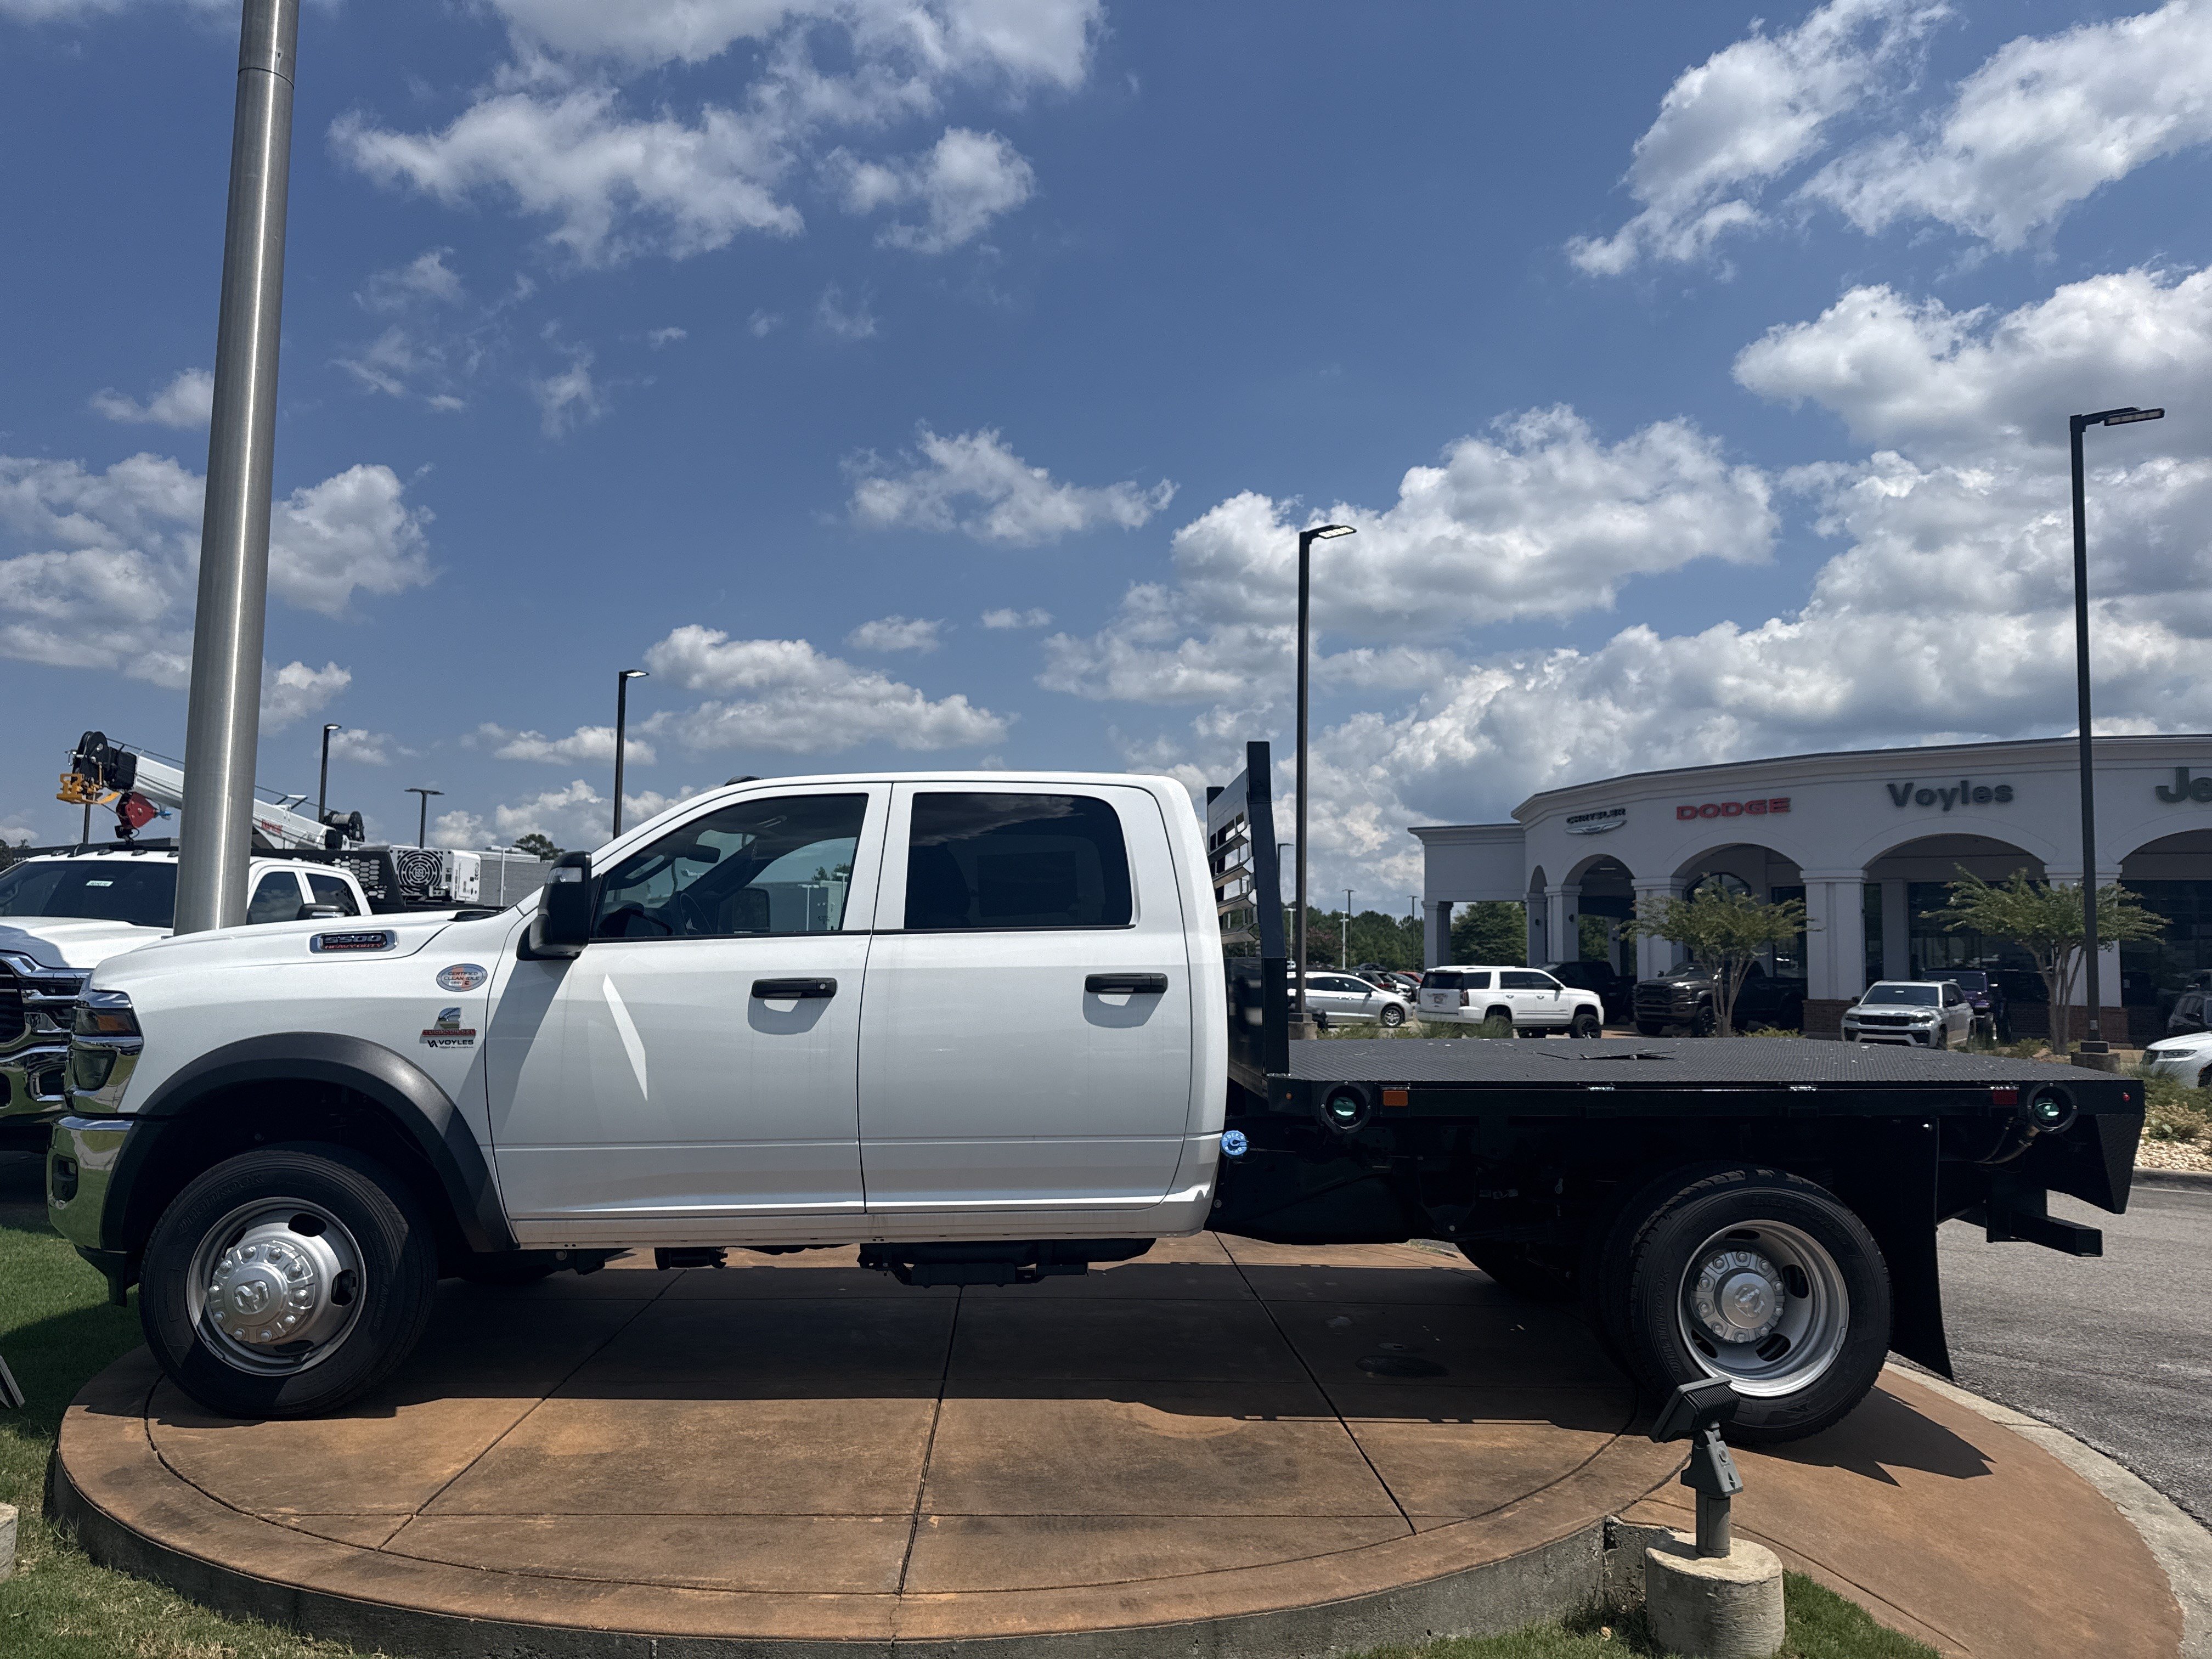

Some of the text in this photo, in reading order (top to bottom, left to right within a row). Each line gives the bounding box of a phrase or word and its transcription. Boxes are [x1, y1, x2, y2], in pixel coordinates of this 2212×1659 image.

[1886, 780, 2013, 811] Voyles
[1677, 797, 1791, 821] DODGE
[325, 935, 382, 944] 5500
